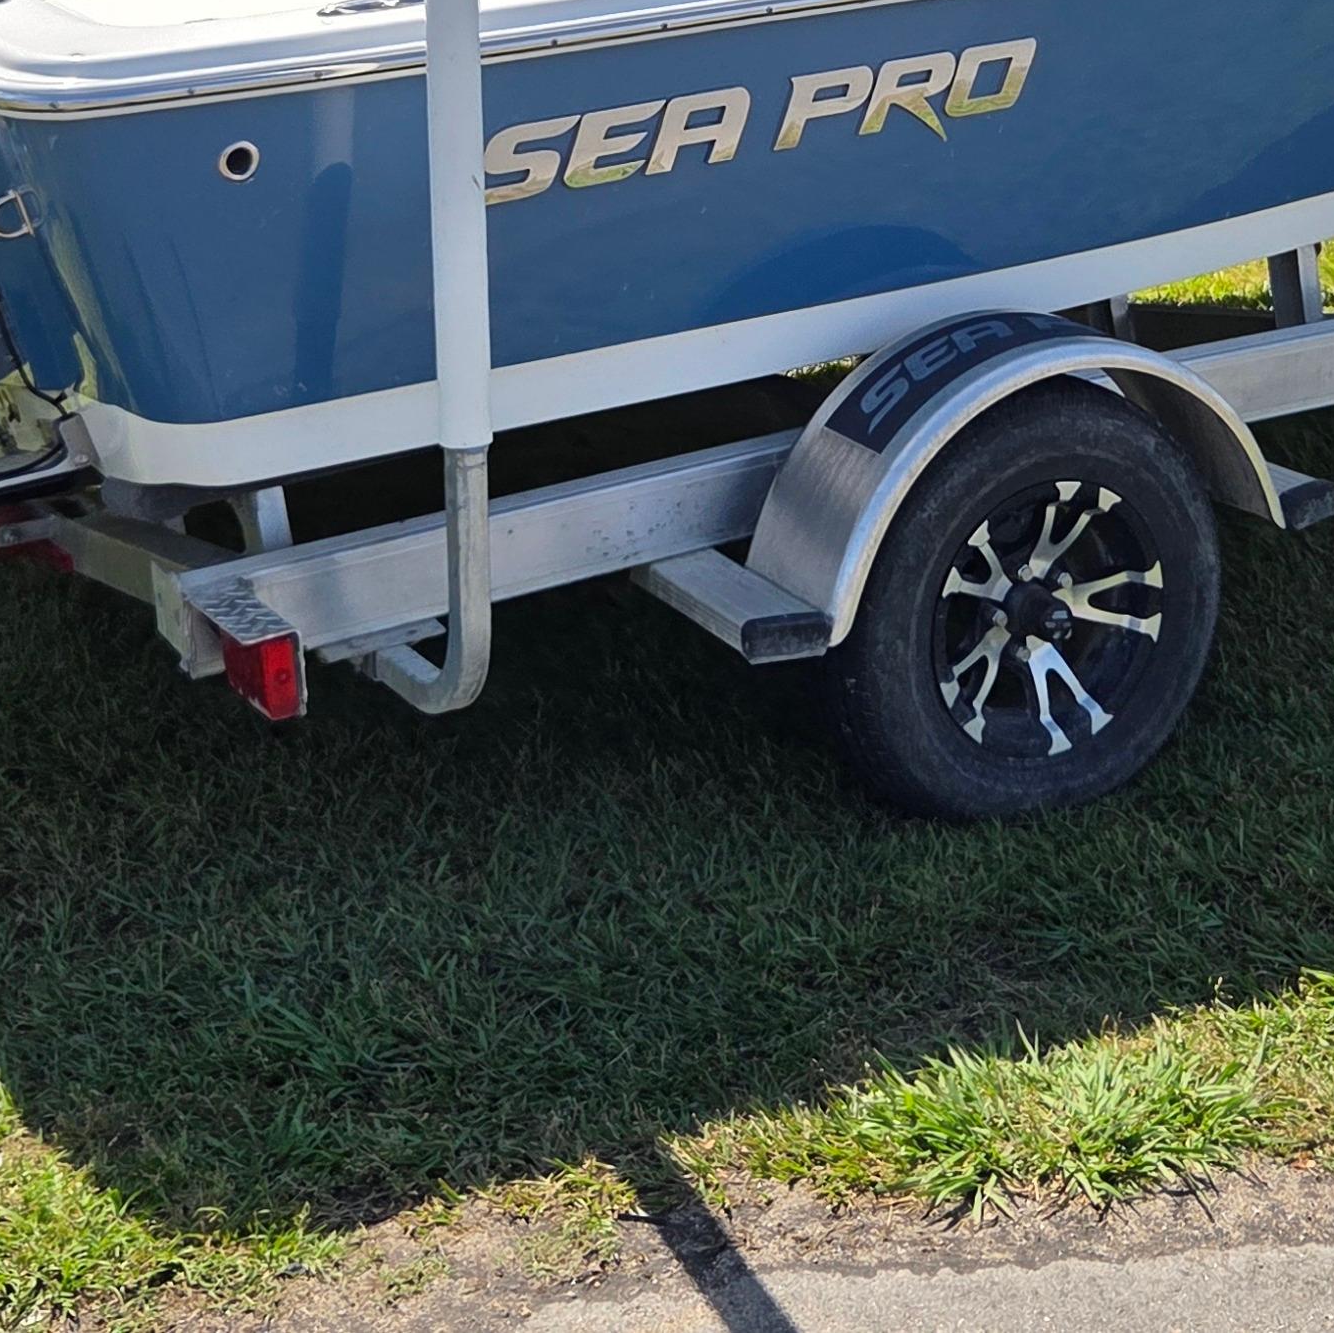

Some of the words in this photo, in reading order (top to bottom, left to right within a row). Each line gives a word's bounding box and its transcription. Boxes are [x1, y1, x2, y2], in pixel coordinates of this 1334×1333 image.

[484, 86, 751, 206] SEA
[773, 37, 1037, 151] PRO
[860, 319, 1014, 435] SEA
